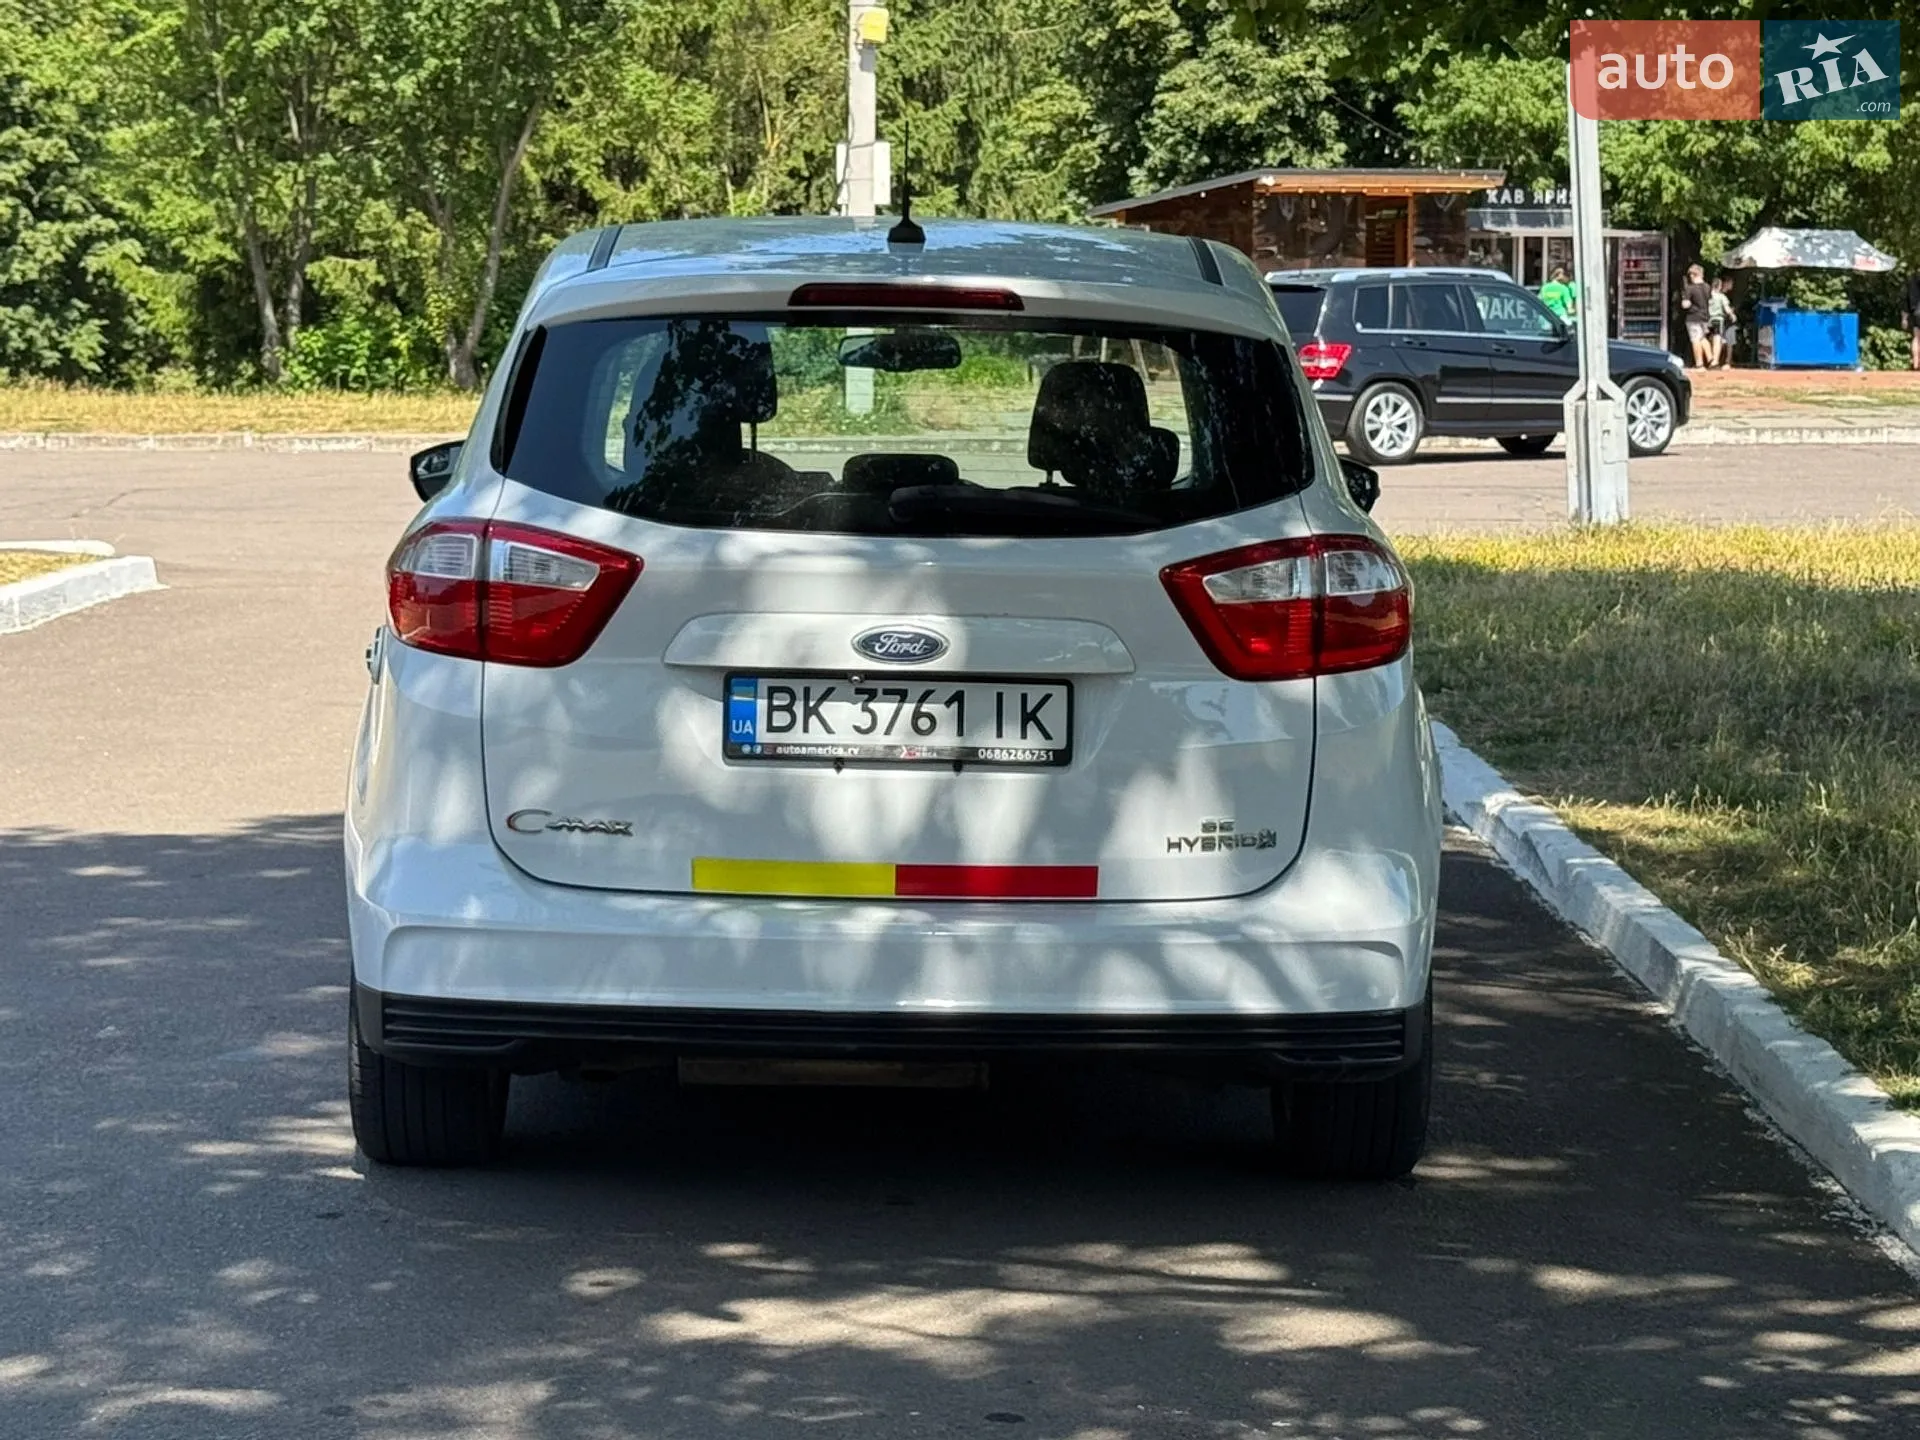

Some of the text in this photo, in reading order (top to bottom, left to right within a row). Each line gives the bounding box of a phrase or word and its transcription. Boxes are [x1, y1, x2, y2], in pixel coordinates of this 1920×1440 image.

[872, 632, 929, 655] Ford
[766, 685, 1054, 741] BK 3761 IK
[732, 719, 754, 734] UA
[978, 748, 1054, 761] 0686266751
[1166, 834, 1258, 853] HYBRID
